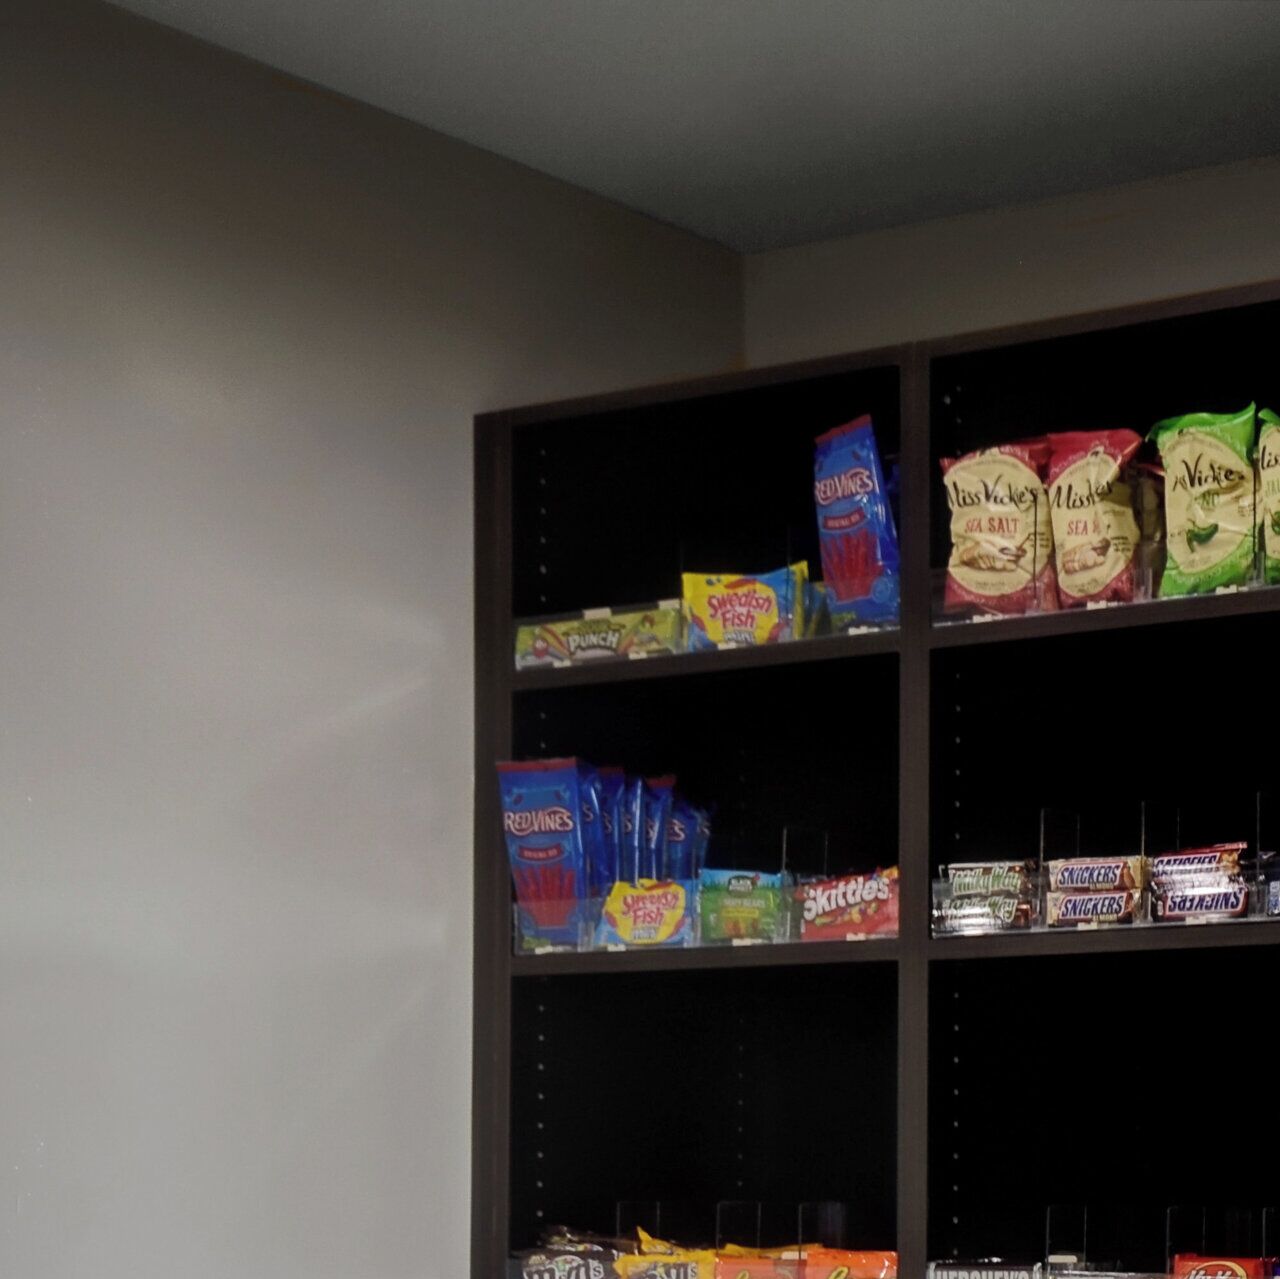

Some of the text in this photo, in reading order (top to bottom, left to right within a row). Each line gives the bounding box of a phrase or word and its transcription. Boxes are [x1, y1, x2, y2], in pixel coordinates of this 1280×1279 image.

[965, 517, 1020, 534] SEA SALT
[1067, 520, 1089, 536] SEA
[721, 609, 757, 631] Fish
[568, 630, 620, 653] PUNCH
[1058, 864, 1122, 887] SNICKERS
[804, 876, 890, 920] Skittles
[1061, 895, 1125, 918] SNICKERS
